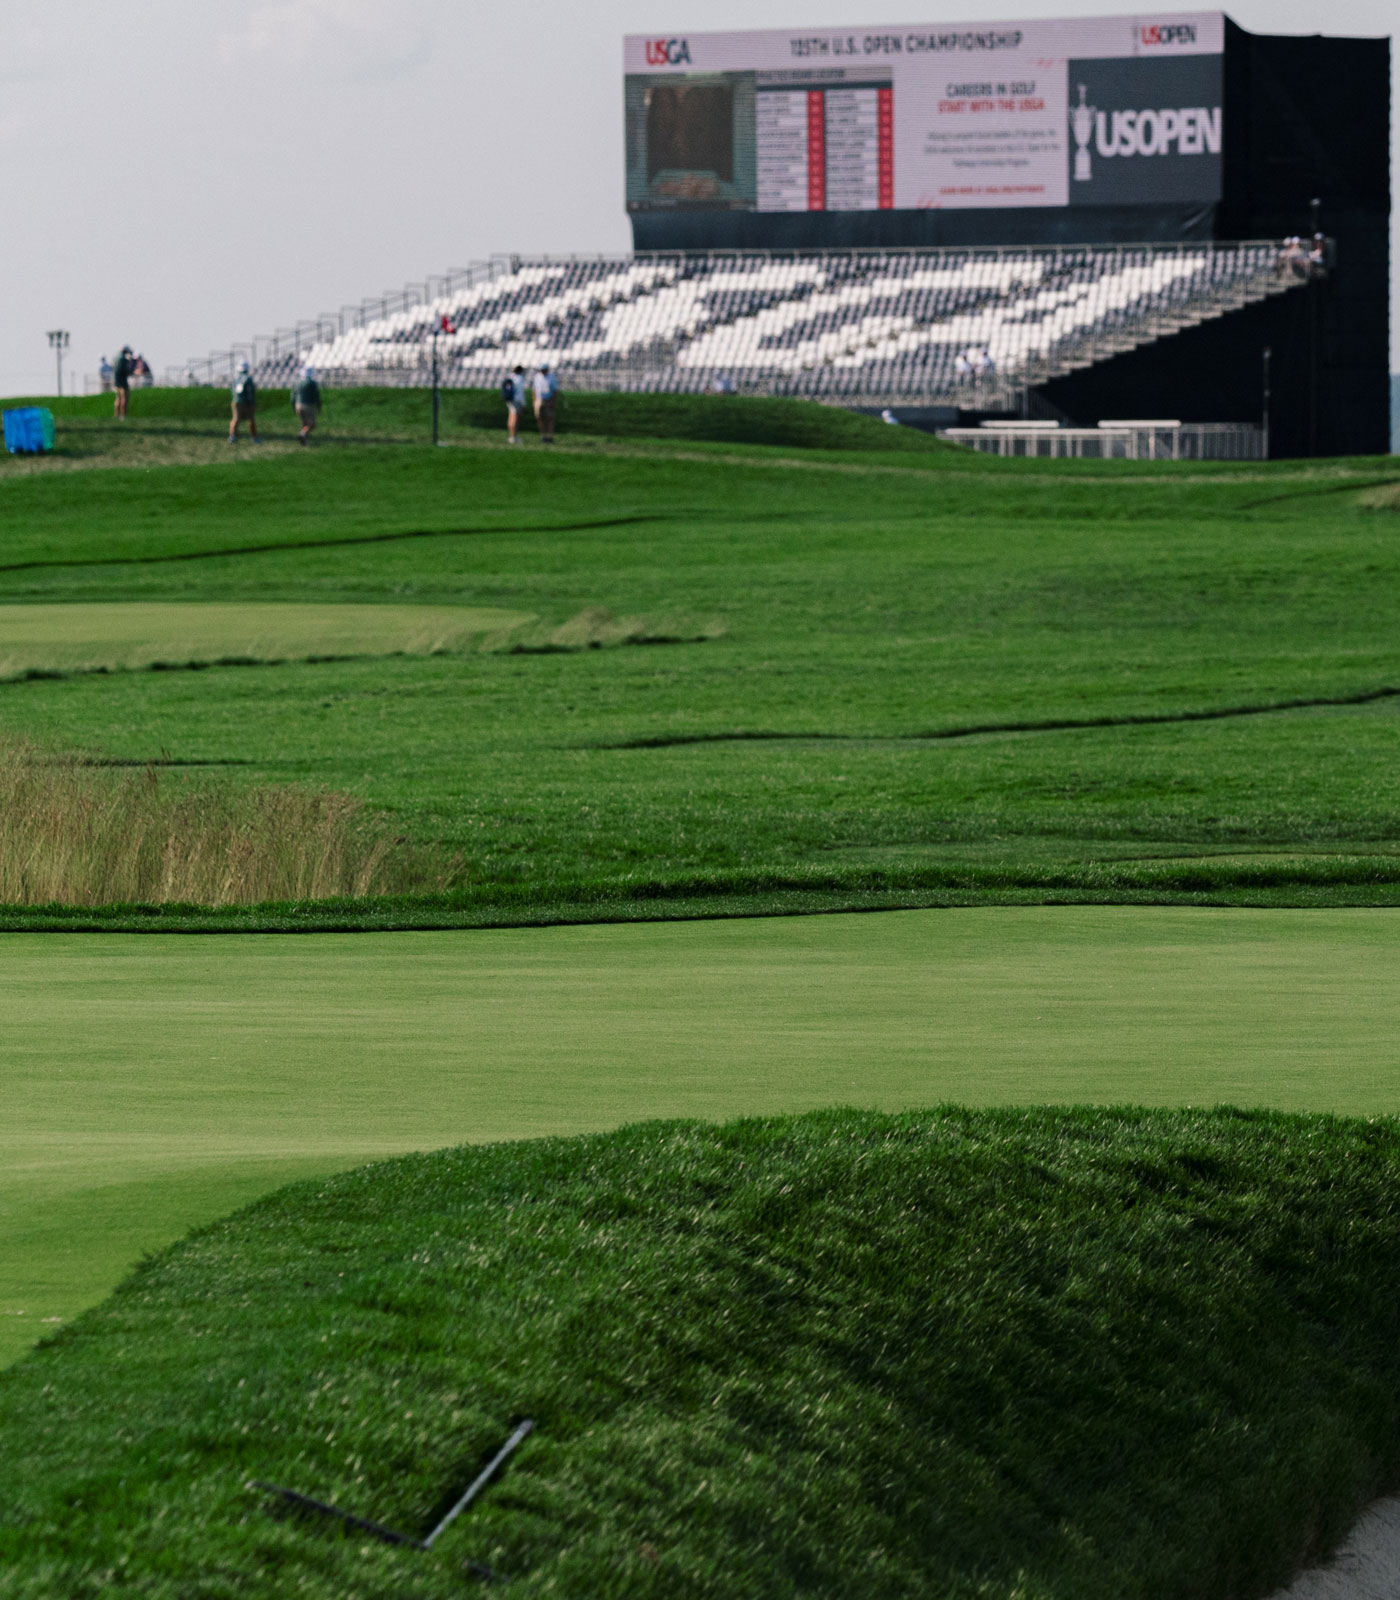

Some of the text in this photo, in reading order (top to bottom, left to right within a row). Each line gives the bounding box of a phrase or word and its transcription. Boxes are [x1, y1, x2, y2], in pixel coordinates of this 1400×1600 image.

[645, 39, 692, 65] USGA
[863, 35, 902, 54] OPEN
[905, 30, 1023, 53] CHAMPIONSHIP
[946, 80, 1036, 98] CAREERS IN GOLF
[937, 100, 965, 114] START
[969, 100, 994, 112] WITH
[997, 99, 1015, 112] THE
